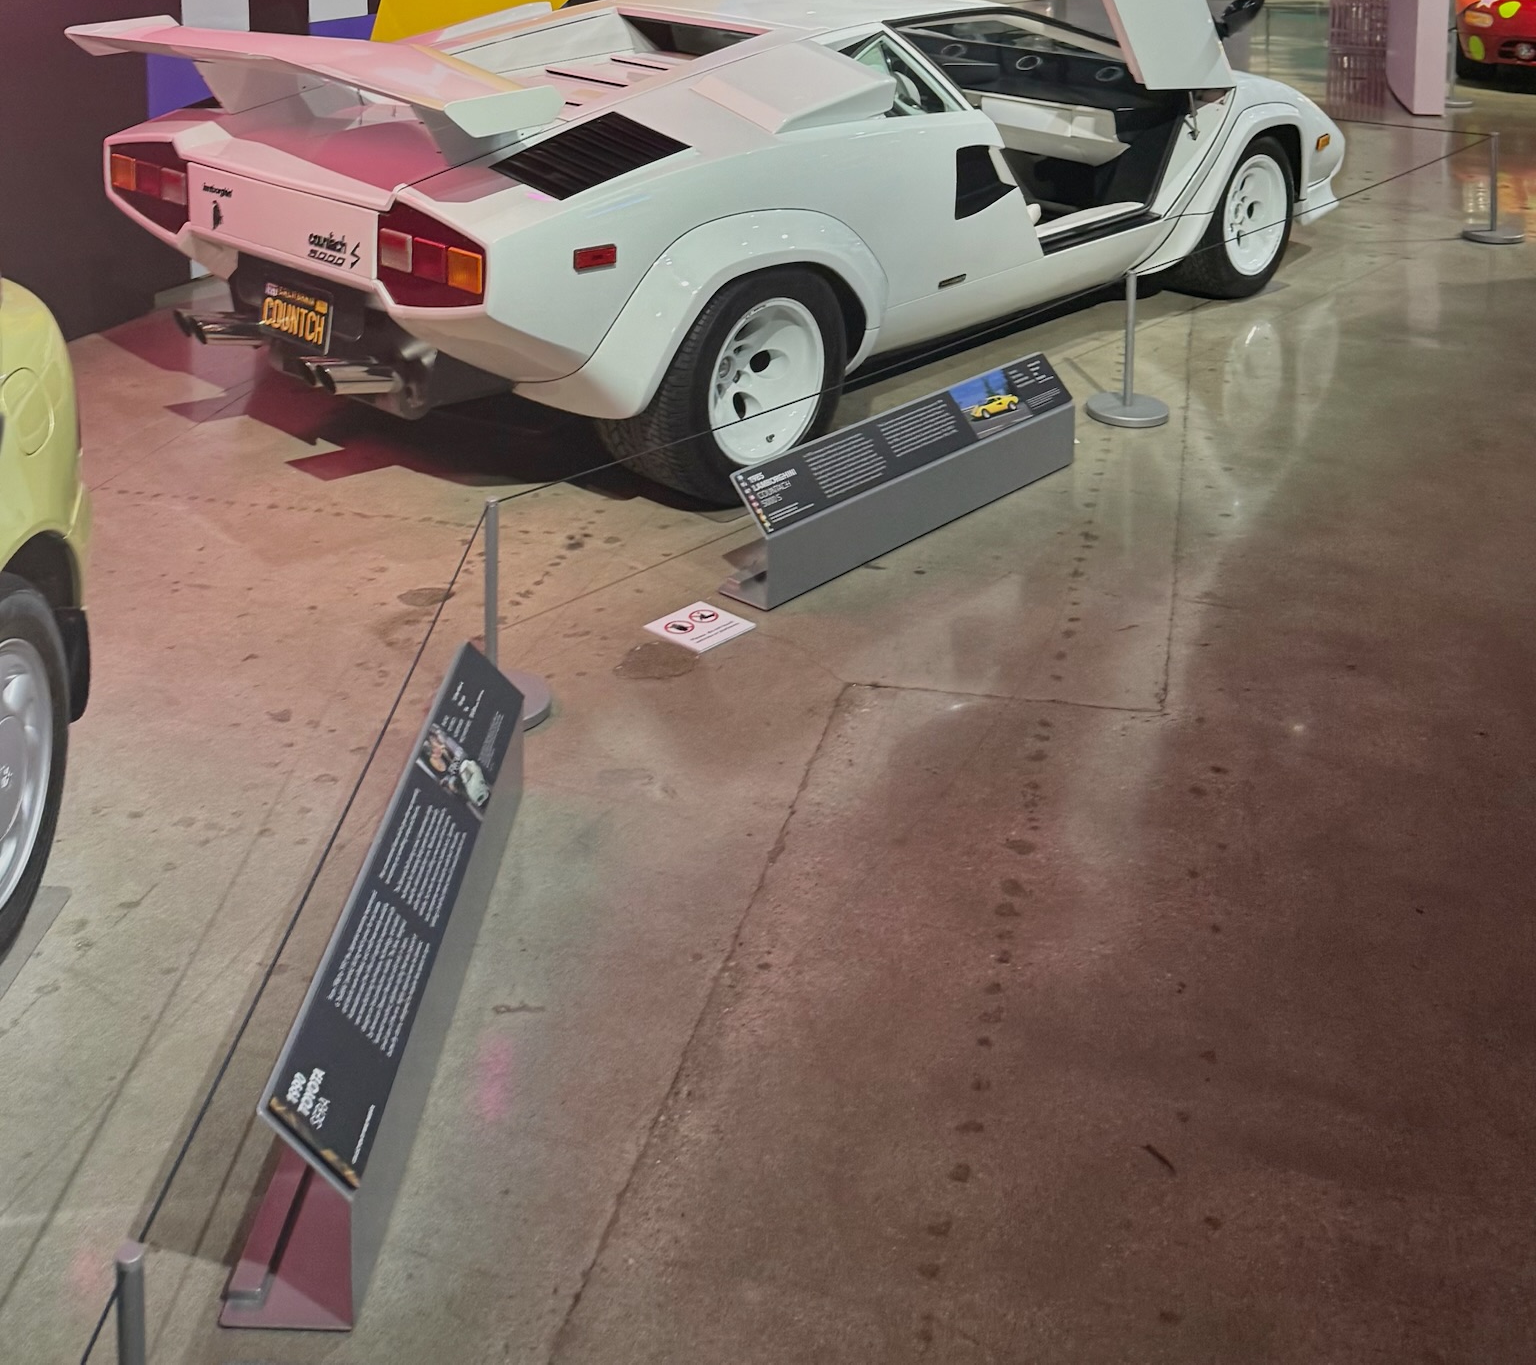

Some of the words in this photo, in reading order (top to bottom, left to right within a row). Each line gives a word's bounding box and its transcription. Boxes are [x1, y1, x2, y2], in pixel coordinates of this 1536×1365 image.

[308, 248, 346, 267] 5000
[261, 296, 326, 346] COUNTCH
[297, 1067, 326, 1117] TOYOTA
[309, 1096, 331, 1130] SERA
